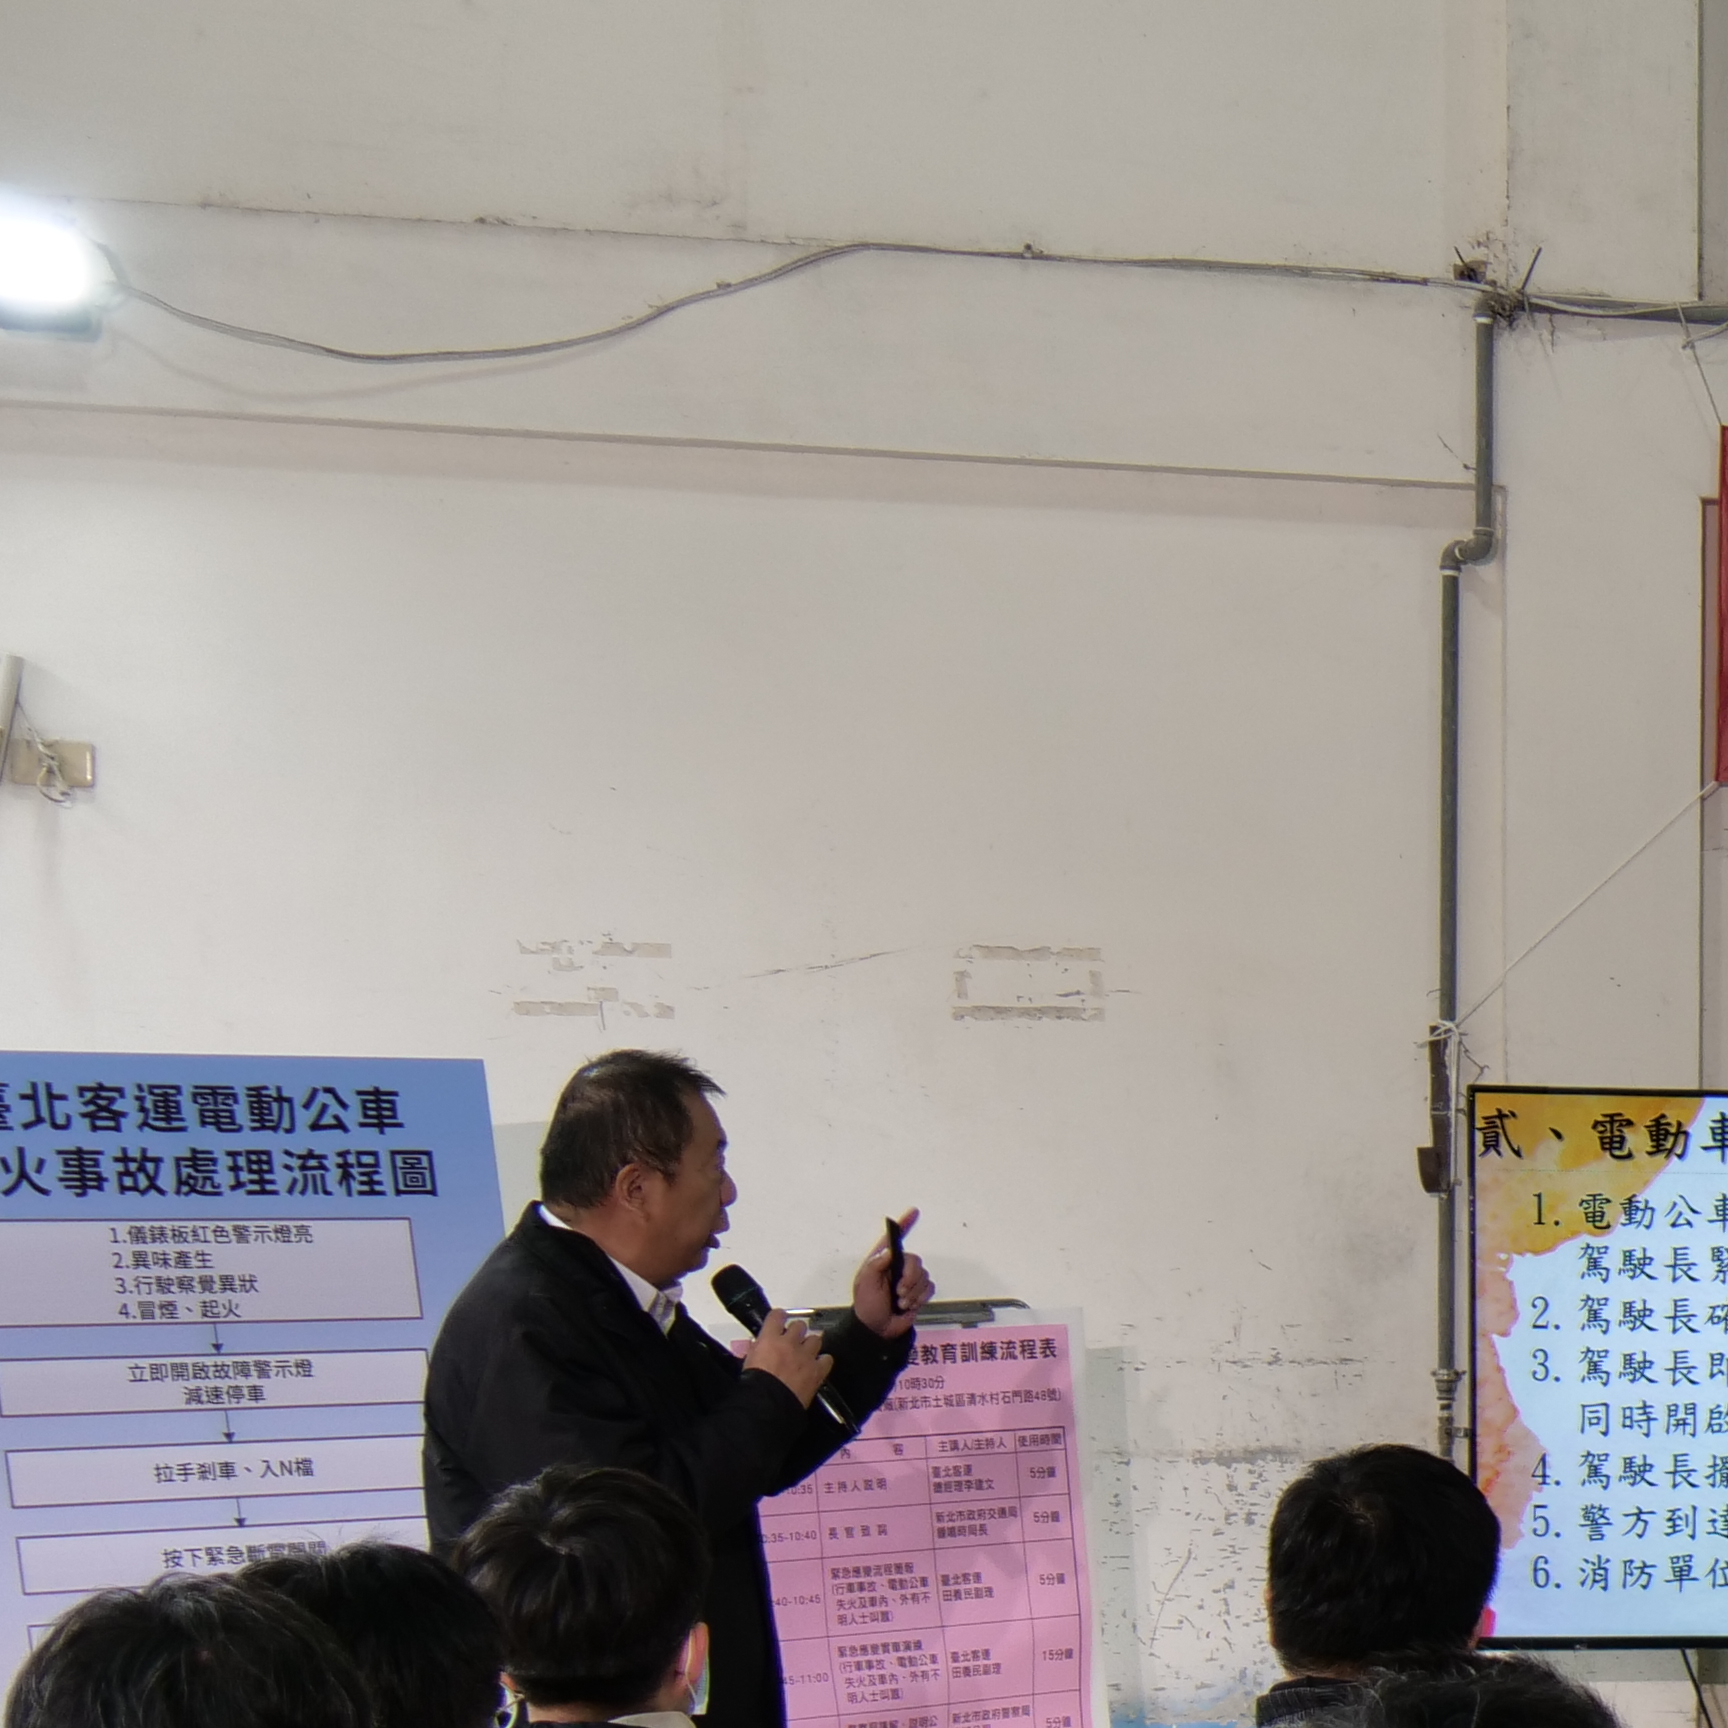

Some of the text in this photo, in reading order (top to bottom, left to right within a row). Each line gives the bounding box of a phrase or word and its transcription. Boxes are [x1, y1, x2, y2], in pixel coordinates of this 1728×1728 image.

[0, 1081, 404, 1135] 北客運電動公車
[0, 1147, 440, 1198] 火事故處理流程圖
[183, 1384, 267, 1405] 減速停車
[894, 1375, 945, 1391] 10時30分
